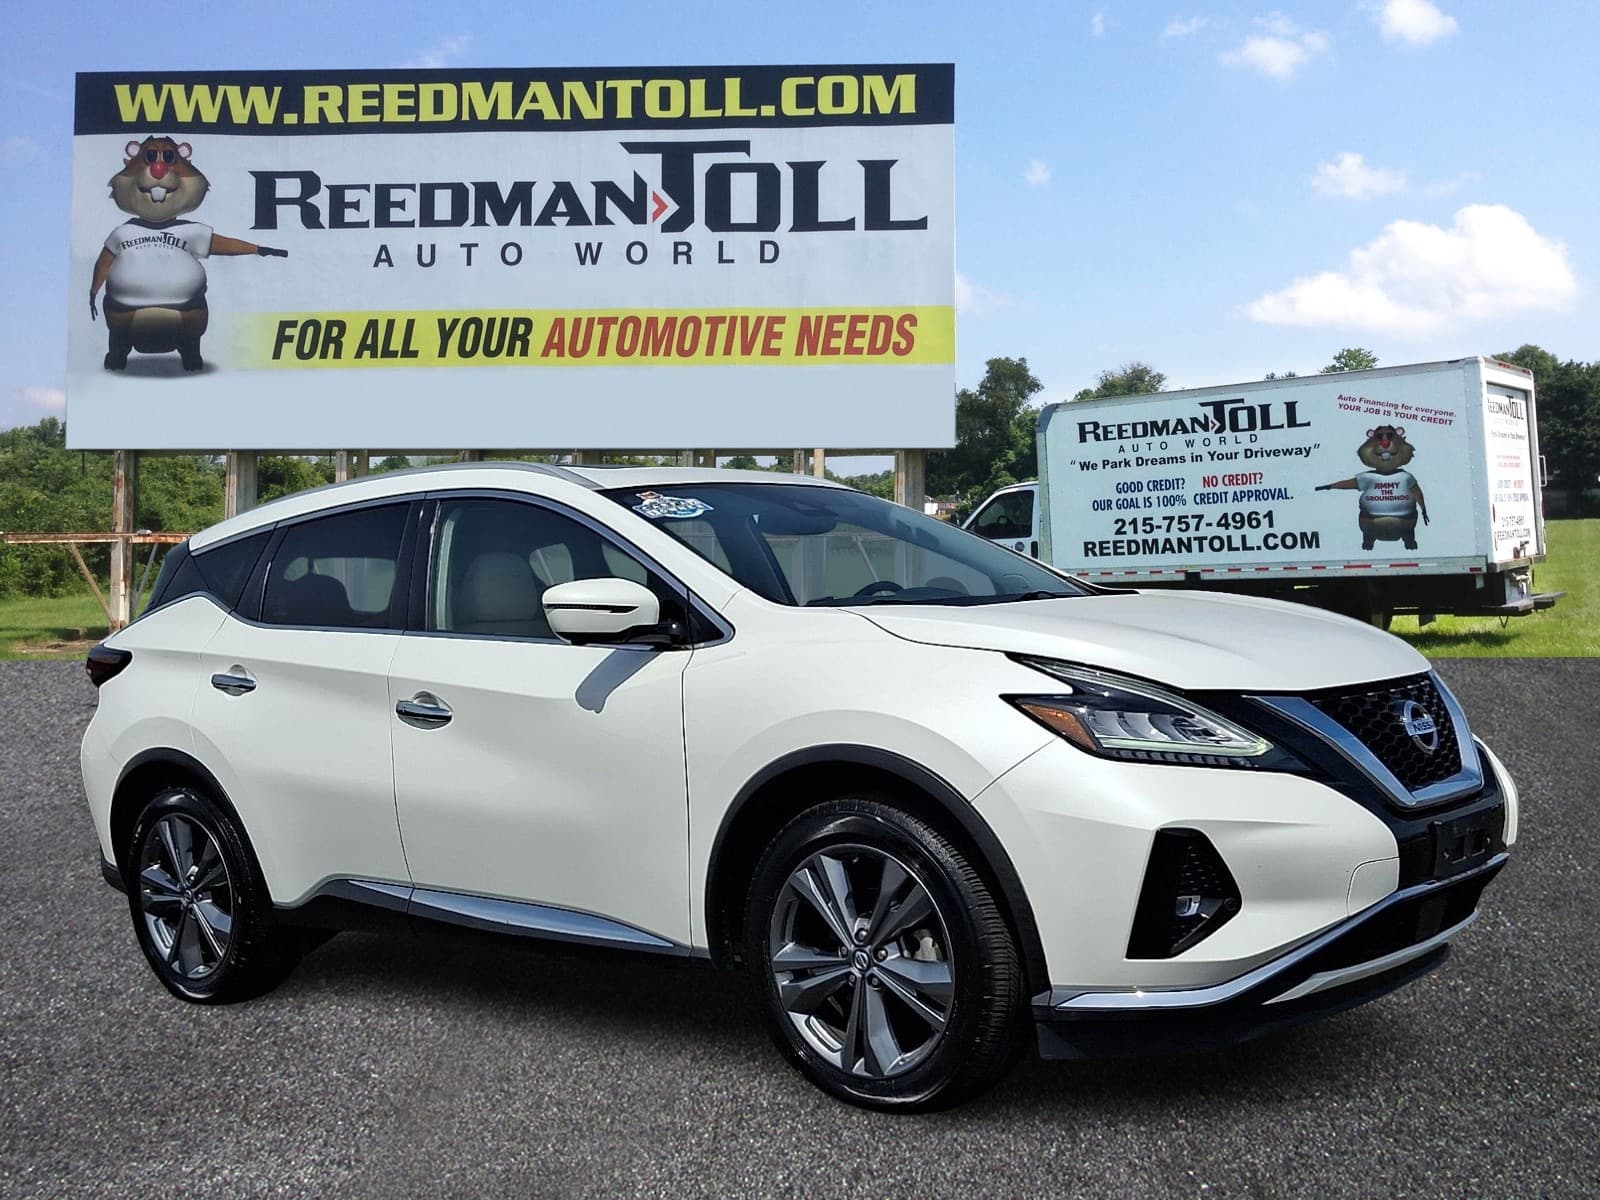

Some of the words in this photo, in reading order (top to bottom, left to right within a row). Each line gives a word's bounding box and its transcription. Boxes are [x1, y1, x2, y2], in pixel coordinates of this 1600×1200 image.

[113, 74, 917, 125] WWW.REEDMANTOLL.COM
[373, 241, 523, 268] AUTO
[574, 240, 780, 266] WORLD
[272, 319, 347, 360] FOR
[354, 318, 419, 359] ALL
[437, 317, 533, 358] YOUR
[541, 315, 786, 358] AUTOMOTIVE
[795, 313, 918, 357] NEEDS
[1338, 394, 1357, 403] Auto
[1359, 397, 1399, 409] Financing
[1401, 403, 1413, 411] for
[1415, 406, 1456, 417] everyone.
[1338, 402, 1361, 412] YOUR
[1363, 405, 1381, 415] JOB
[1383, 409, 1392, 417] IS
[1394, 411, 1418, 421] YOUR
[1420, 415, 1454, 426] CREDIT
[1118, 441, 1168, 453] AUTO
[1185, 433, 1258, 449] WORLD
[1102, 457, 1131, 469] Park
[1136, 453, 1186, 467] Dreams
[1191, 452, 1203, 463] in
[1207, 450, 1240, 462] Your
[1115, 480, 1143, 494] GOOD
[1146, 478, 1186, 492] CREDIT?
[1202, 475, 1219, 488] NO
[1222, 472, 1263, 487] CREDIT?
[1092, 499, 1113, 512] OUR
[1115, 497, 1140, 510] GOAL
[1143, 497, 1153, 508] IS
[1156, 494, 1187, 507] 100%
[1193, 491, 1229, 506] CREDIT
[1232, 488, 1294, 503] APPROVAL.
[1114, 510, 1275, 536] 215-757-4961
[1083, 531, 1321, 558] REEDMANTOLL.COM
